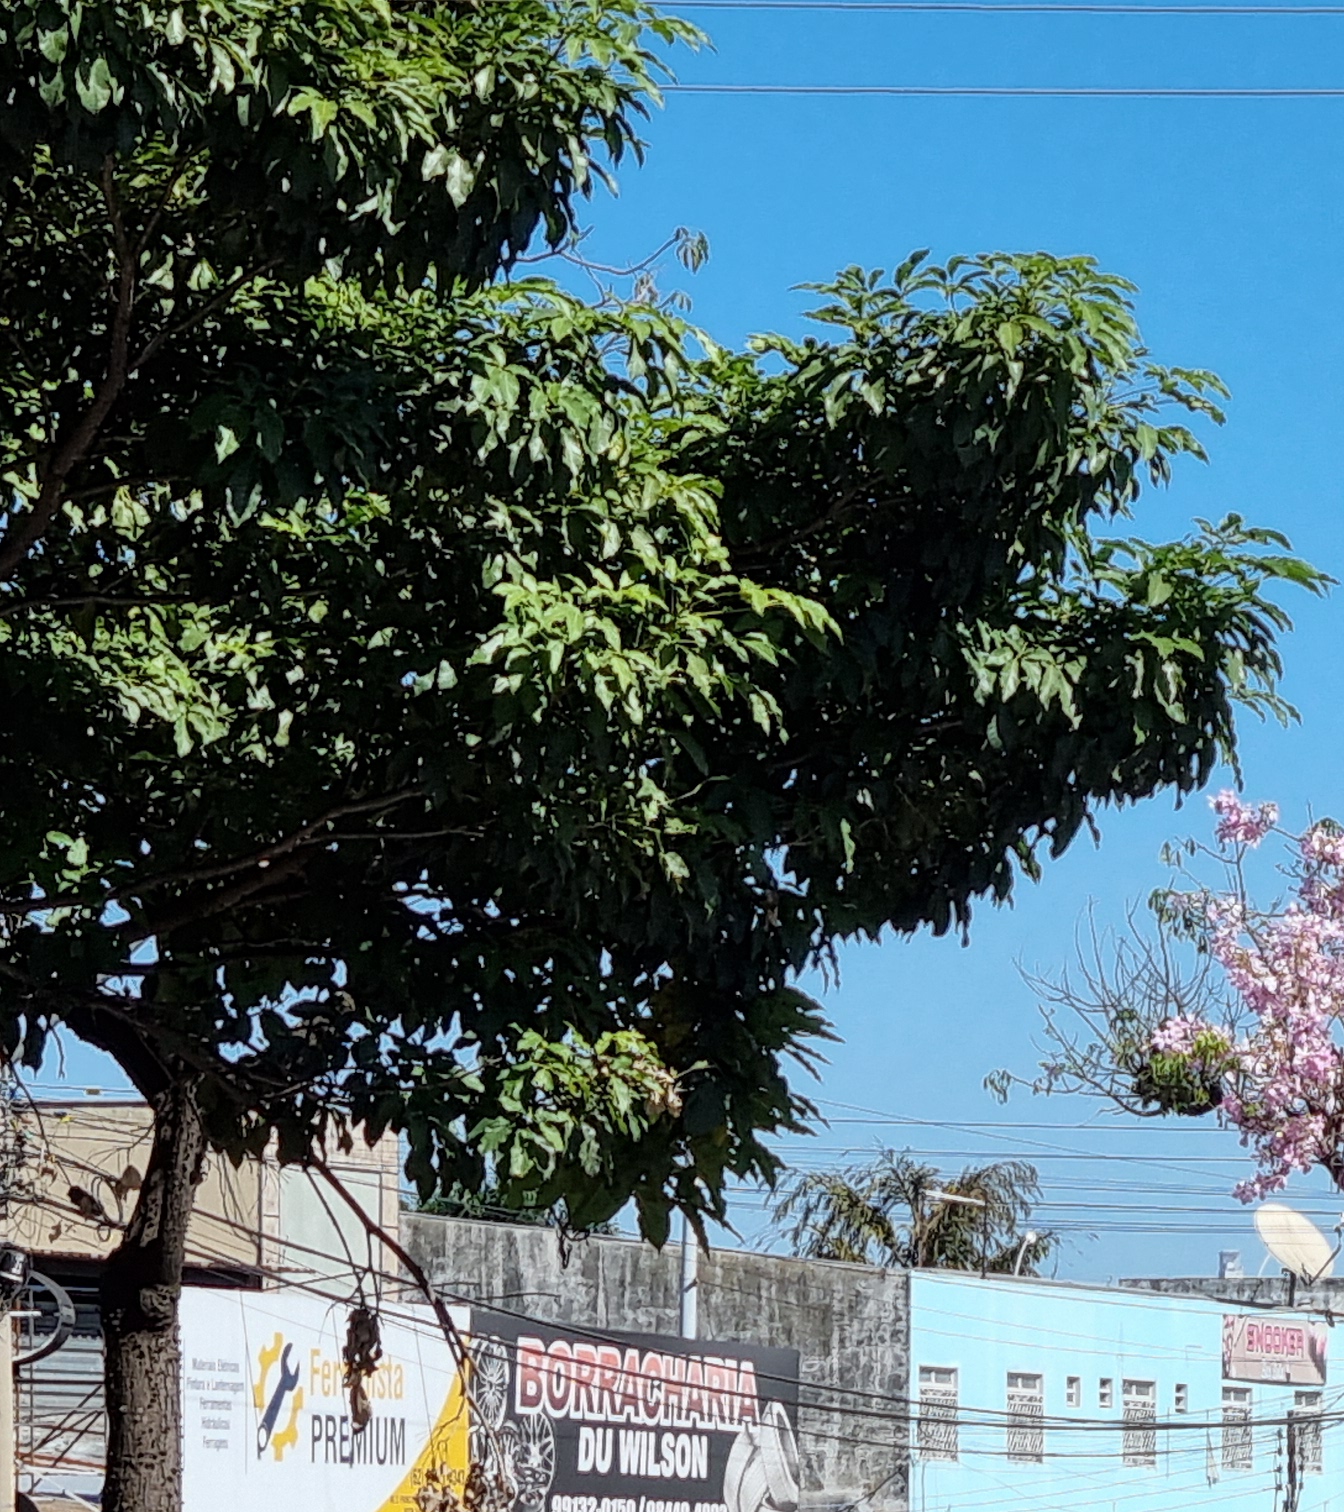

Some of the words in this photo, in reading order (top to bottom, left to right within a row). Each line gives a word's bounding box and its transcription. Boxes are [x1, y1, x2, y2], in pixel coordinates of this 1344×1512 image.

[515, 1334, 760, 1432] BORRACHARIA
[577, 1426, 612, 1474] DU
[619, 1428, 708, 1479] WILSON
